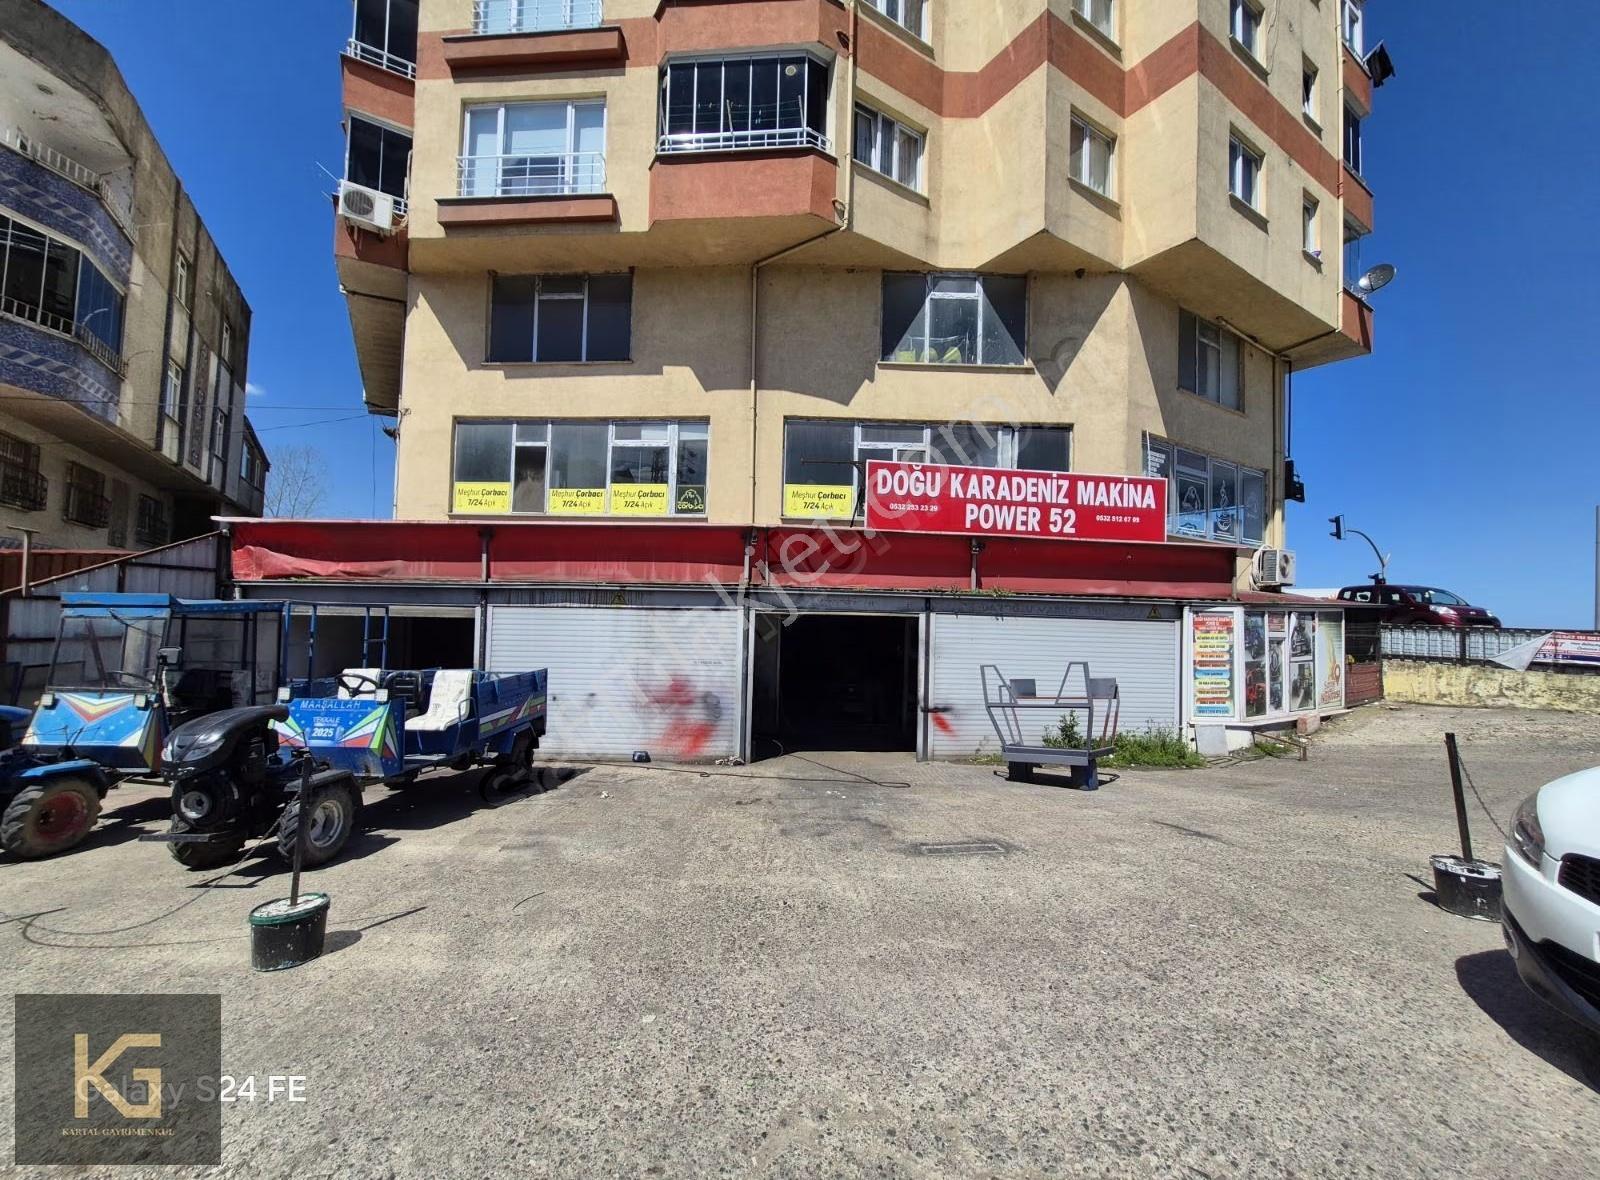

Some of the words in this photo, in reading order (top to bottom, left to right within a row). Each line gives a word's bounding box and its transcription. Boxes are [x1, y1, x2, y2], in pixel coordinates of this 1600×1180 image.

[876, 463, 941, 498] DOĞU
[950, 472, 1070, 505] KARADENİZ
[1076, 477, 1157, 509] MAKİNA
[481, 488, 508, 498] Çorbacı
[575, 489, 604, 499] Çorbacı
[637, 489, 665, 499] Çorbacı
[791, 490, 816, 500] Meşhur
[817, 491, 847, 501] Çorbacı
[467, 498, 483, 506] 7/24
[562, 500, 578, 508] 7/24
[623, 500, 640, 508] 7/24
[803, 501, 820, 510] 7/24
[889, 502, 906, 510] 0532
[965, 503, 1041, 531] POWER
[1049, 508, 1077, 534] 52
[311, 726, 335, 737] 2025
